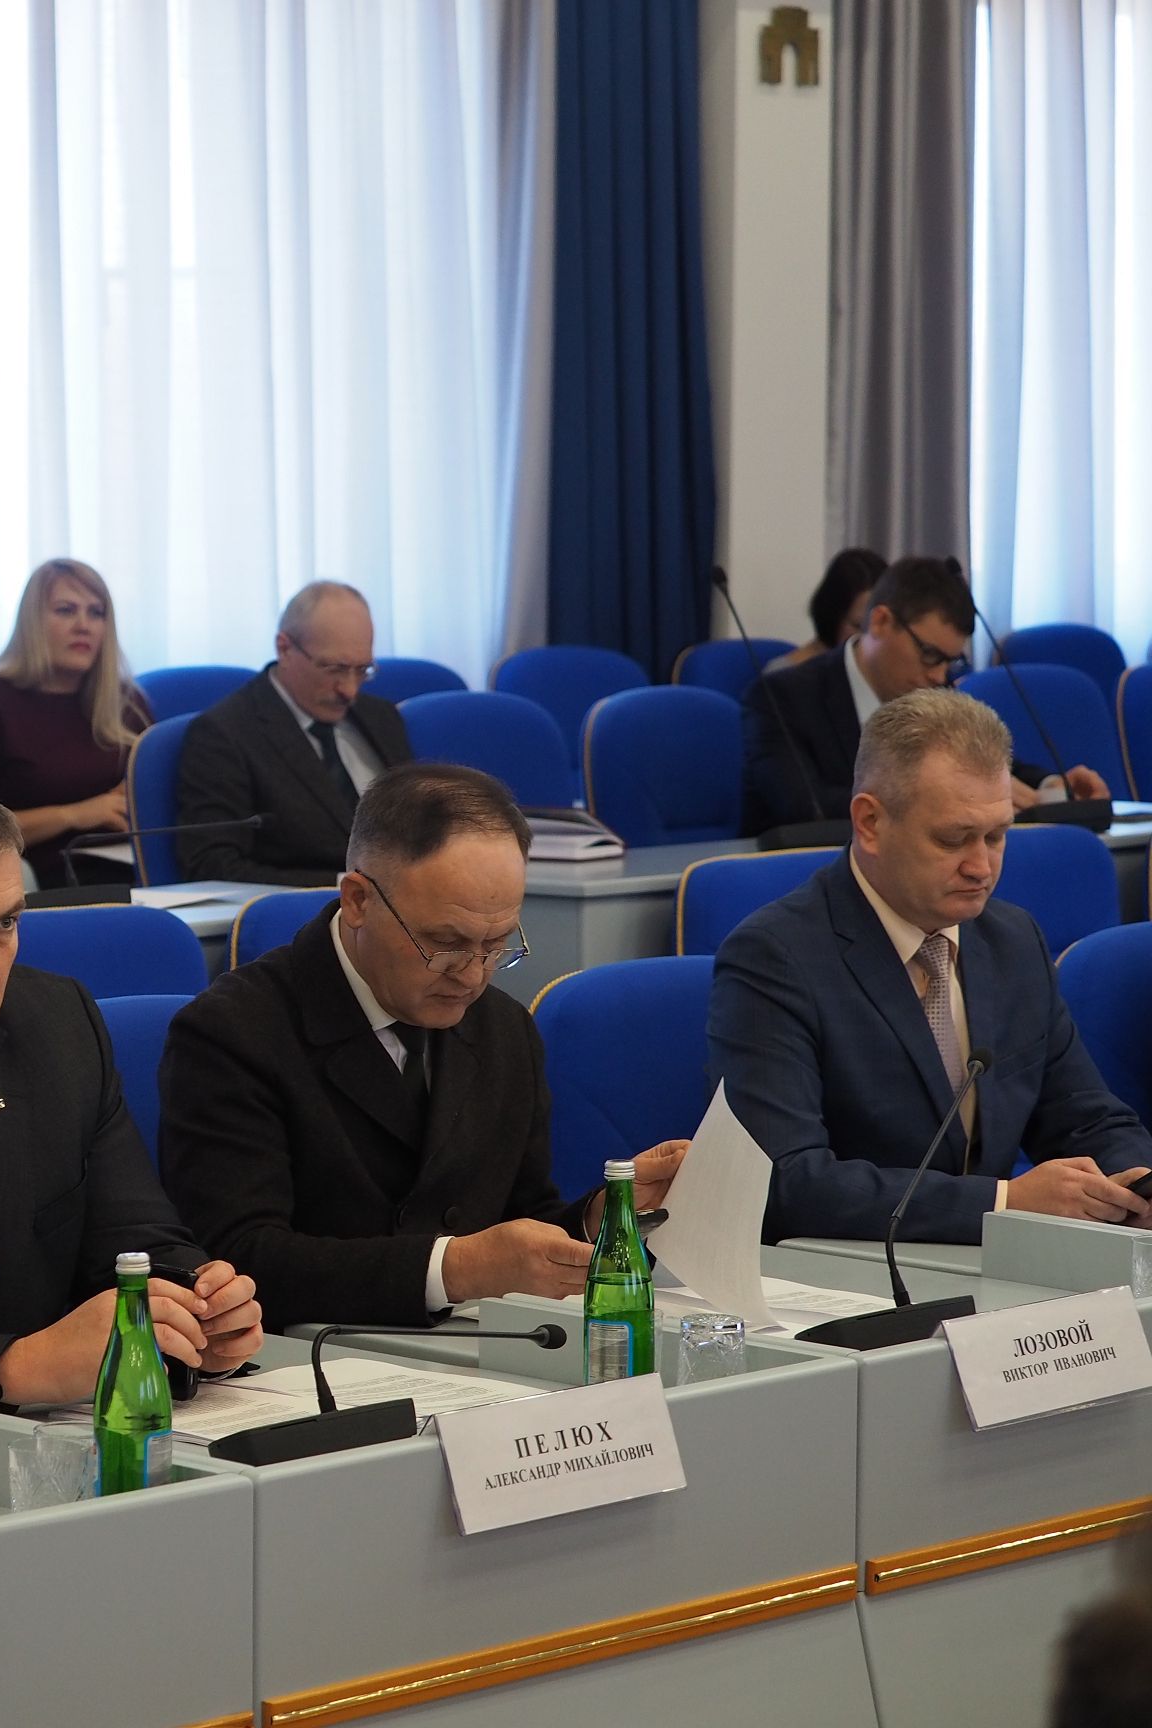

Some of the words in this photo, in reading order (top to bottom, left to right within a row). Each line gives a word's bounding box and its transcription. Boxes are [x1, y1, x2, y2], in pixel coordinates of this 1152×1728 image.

[1013, 1319, 1094, 1358] ЛОЗОВОЙ
[1002, 1361, 1050, 1383] ВИКТОР
[1053, 1346, 1118, 1372] ИВАНОВИЧ
[514, 1420, 613, 1459] ПЕЛЮХ
[484, 1462, 561, 1490] АЛЕКСАНДР
[564, 1443, 655, 1474] МИХАЙЛОВИЧ
